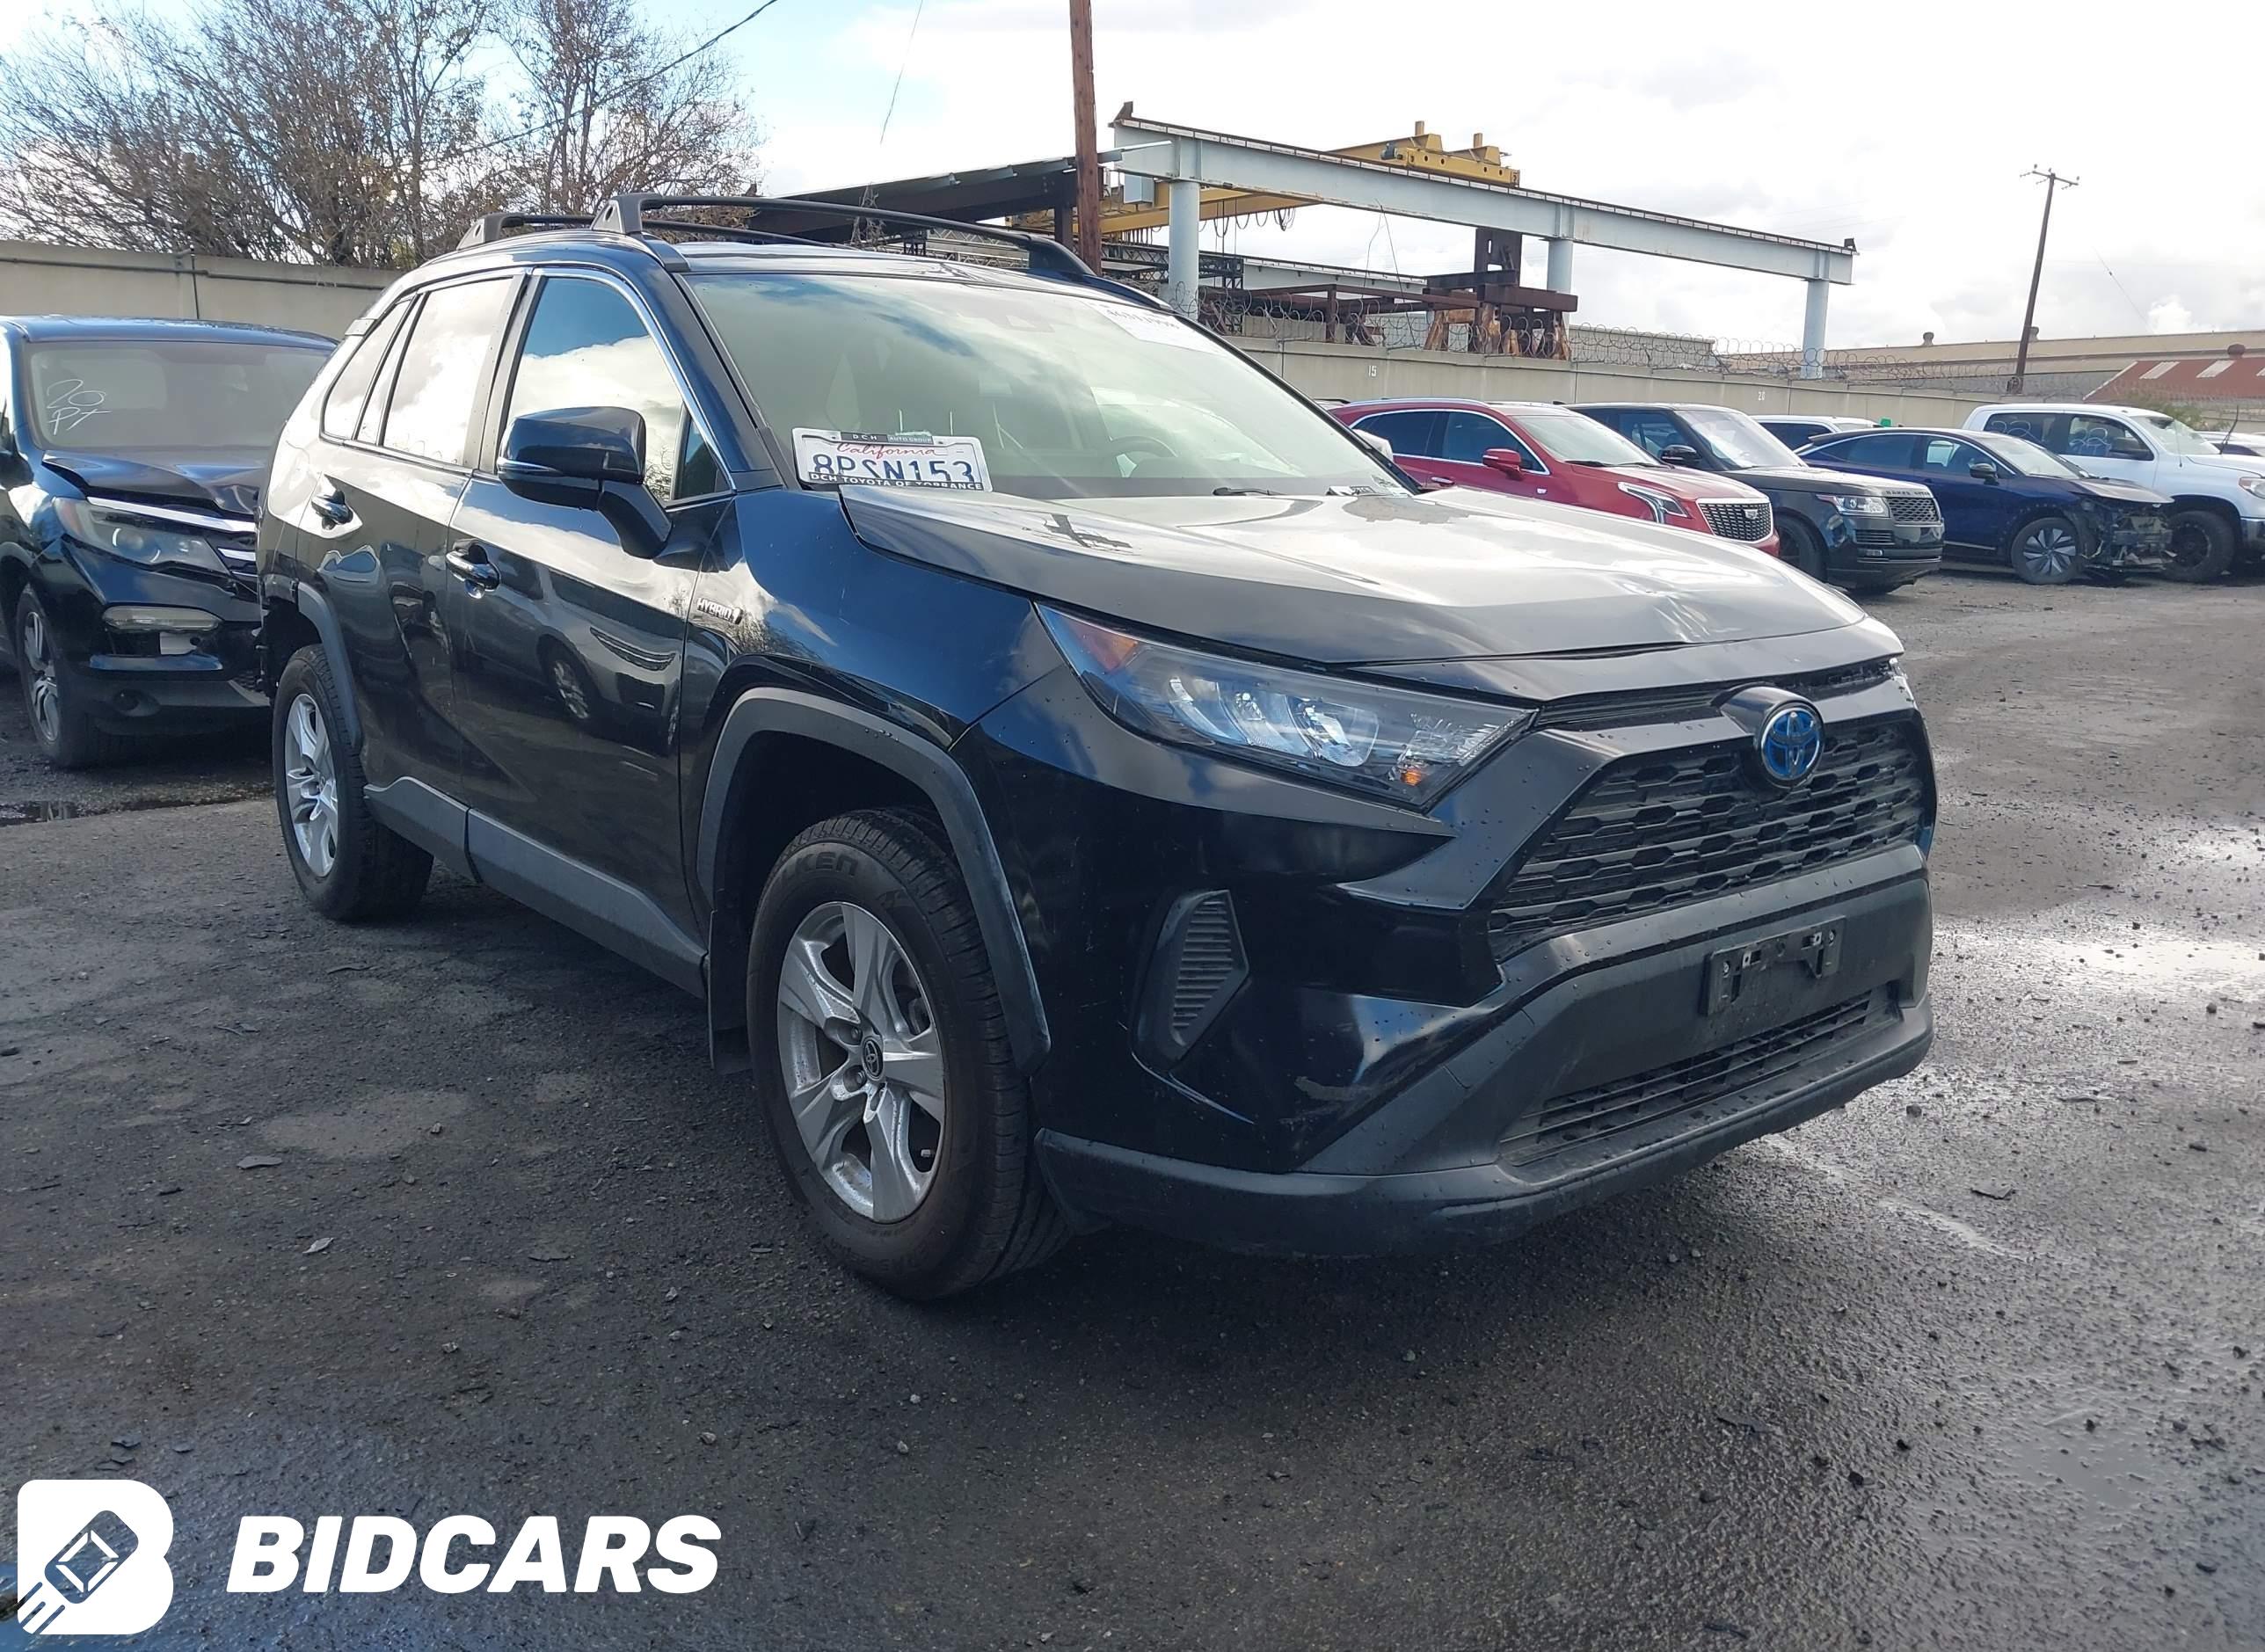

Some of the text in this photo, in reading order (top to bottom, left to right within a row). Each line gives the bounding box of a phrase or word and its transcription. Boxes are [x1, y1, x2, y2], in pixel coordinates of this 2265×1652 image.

[1368, 365, 1377, 377] 15
[47, 378, 106, 409] 20
[837, 443, 936, 460] California
[812, 454, 975, 483] 8PSN153
[811, 473, 837, 482] DCH
[841, 476, 891, 486] TOYOTA
